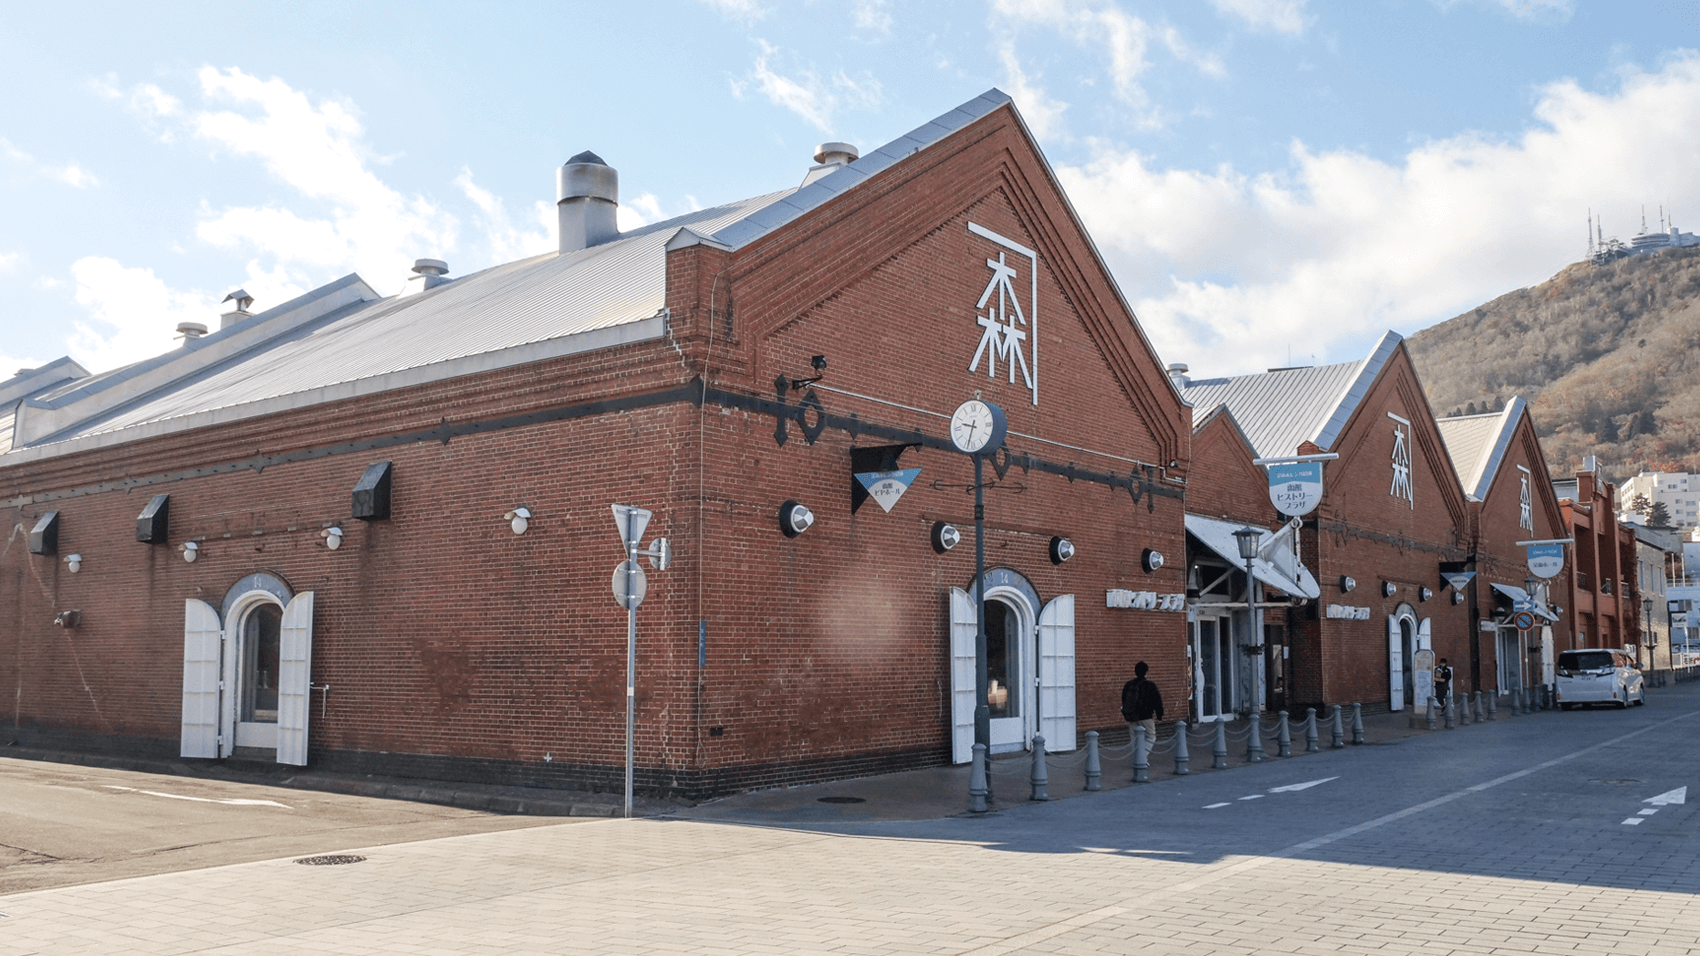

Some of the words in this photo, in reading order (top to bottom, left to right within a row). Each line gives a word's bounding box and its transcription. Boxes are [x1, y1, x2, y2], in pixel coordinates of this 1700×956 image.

[1277, 492, 1313, 501] ヒストリー
[1000, 572, 1009, 584] 14
